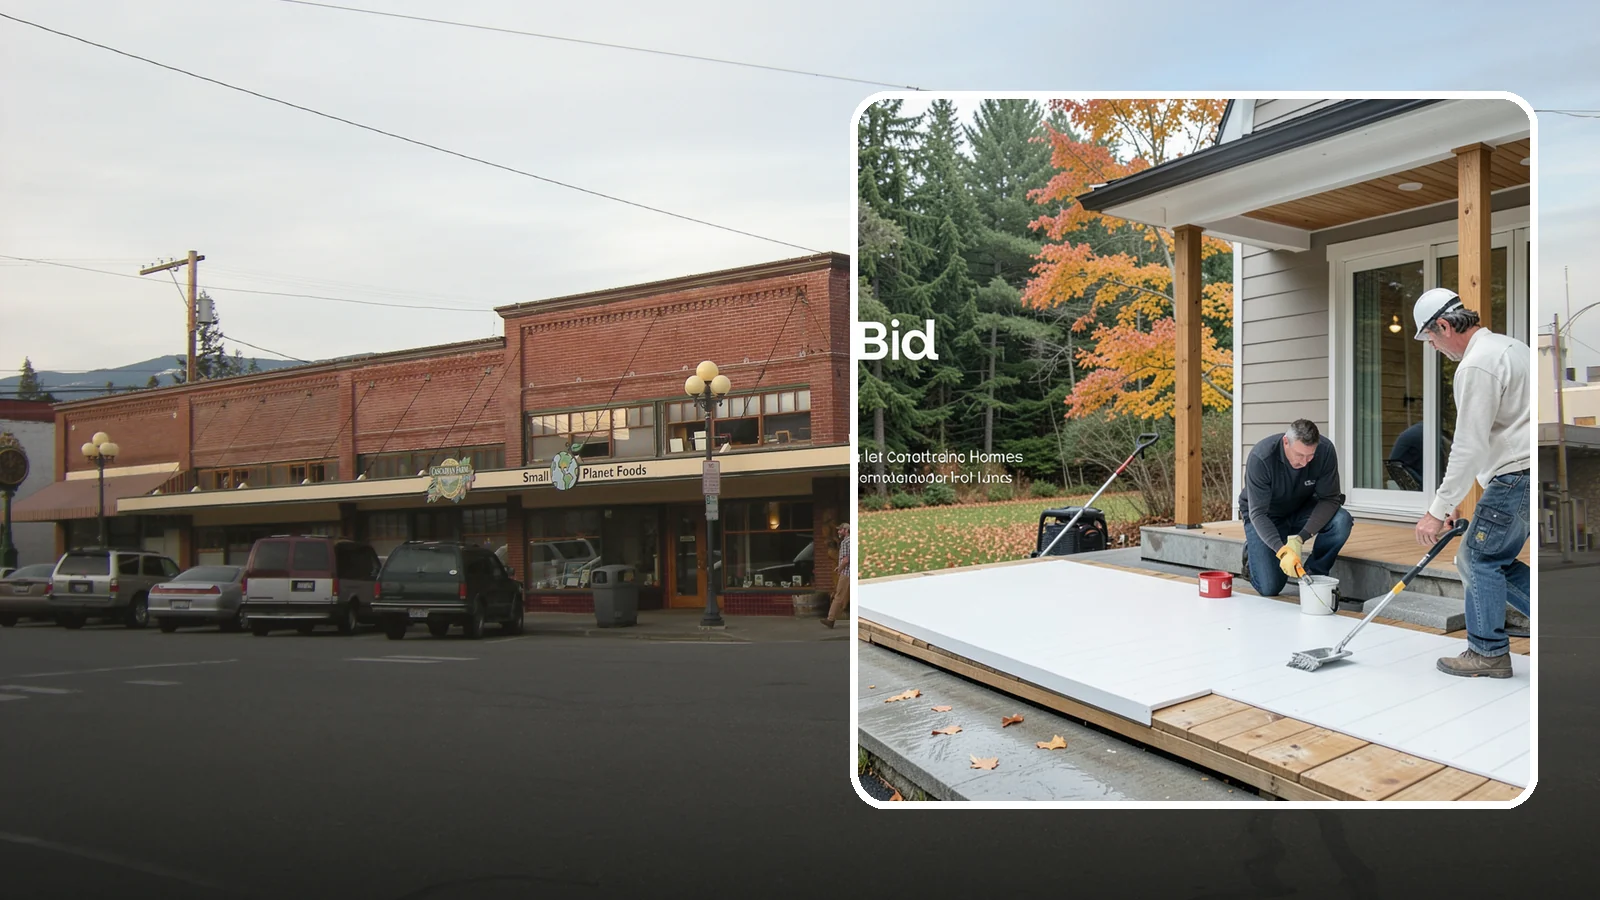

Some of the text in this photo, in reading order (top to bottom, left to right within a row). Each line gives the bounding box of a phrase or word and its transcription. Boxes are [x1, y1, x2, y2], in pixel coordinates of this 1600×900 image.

[523, 464, 647, 483] Small Planet Foods
